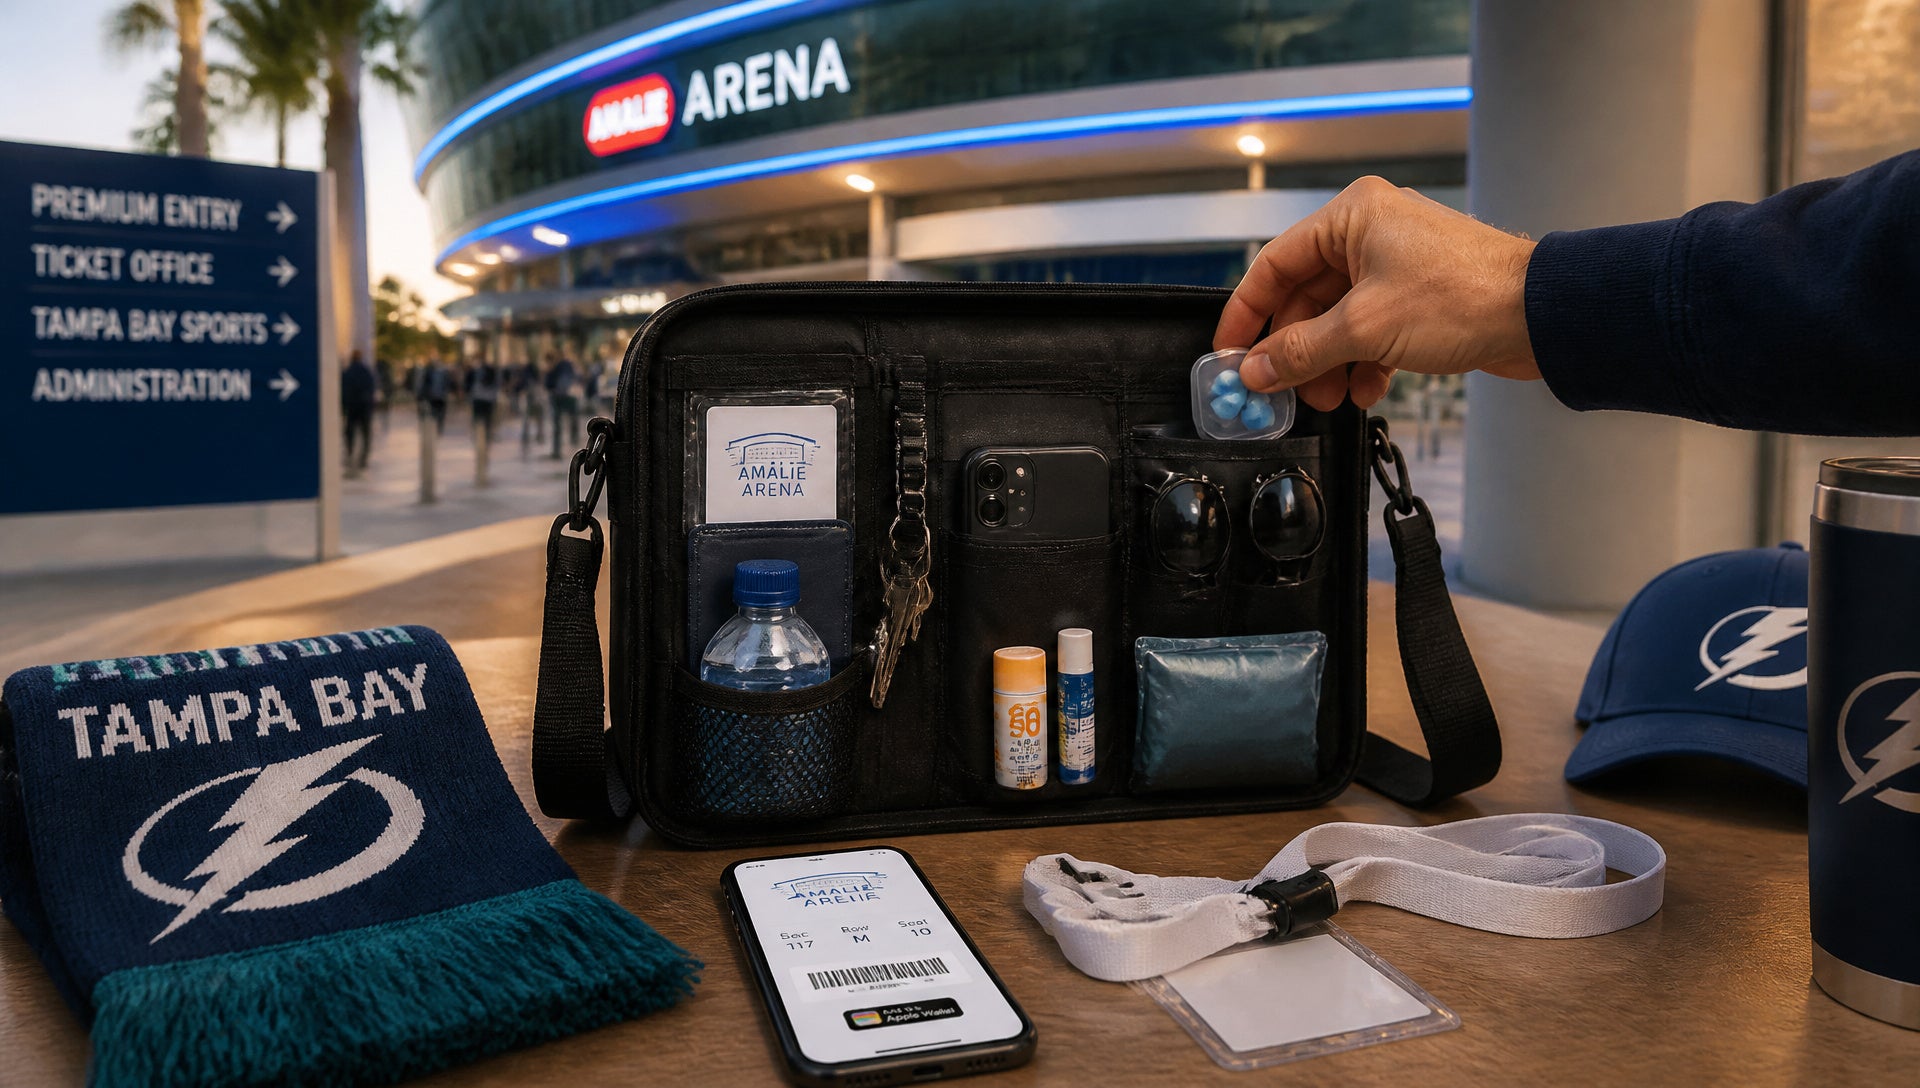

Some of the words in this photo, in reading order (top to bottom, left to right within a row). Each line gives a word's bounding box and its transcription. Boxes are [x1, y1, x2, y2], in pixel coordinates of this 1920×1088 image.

[681, 37, 851, 127] ARENA
[32, 183, 158, 226] PREMIUM
[163, 194, 242, 231] ENTRY
[31, 243, 125, 281] TICKET
[130, 249, 215, 285] OFFICE
[31, 305, 124, 342] TAMPA
[128, 308, 178, 342] BAY
[180, 310, 269, 345] SPORTS
[32, 367, 251, 402] ADMINISTRATION
[742, 482, 804, 496] ARENA
[58, 684, 301, 759] TAMPA
[310, 662, 429, 728] BAY
[787, 940, 814, 950] 117
[853, 934, 871, 943] M
[911, 927, 932, 937] 10
